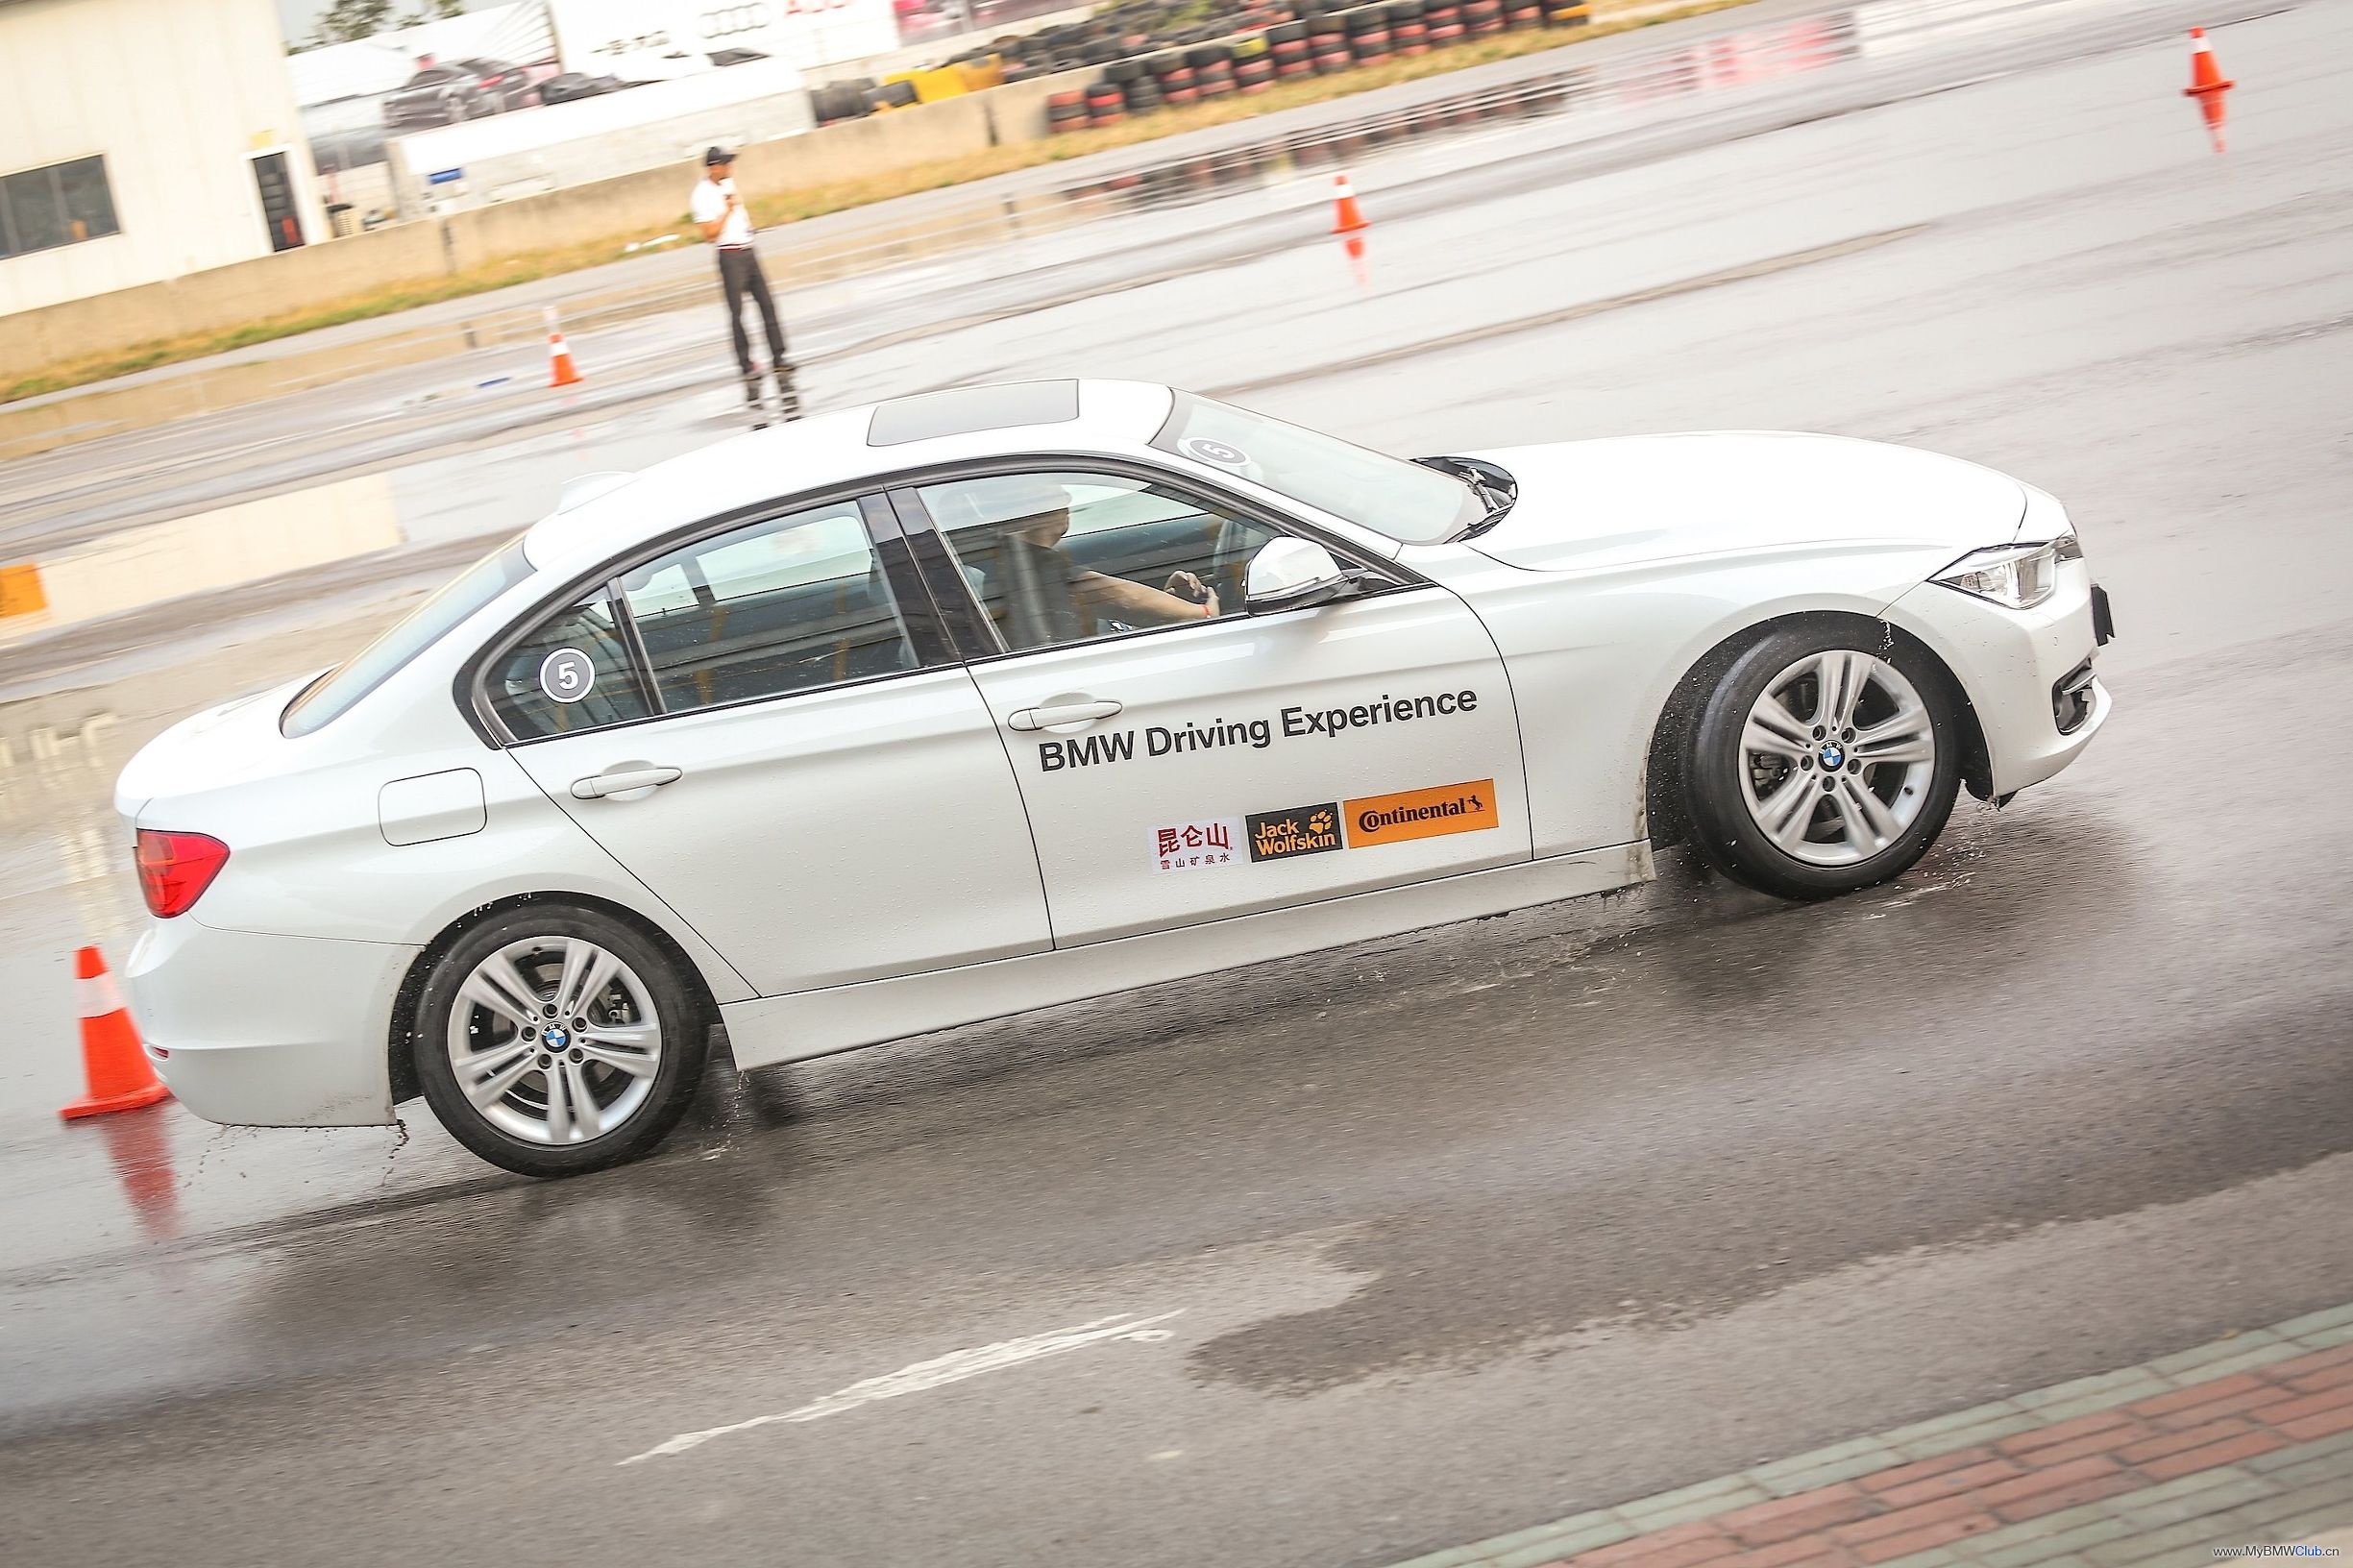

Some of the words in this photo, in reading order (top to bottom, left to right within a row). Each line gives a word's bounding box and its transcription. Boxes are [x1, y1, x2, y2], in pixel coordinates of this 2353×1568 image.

[558, 661, 579, 690] 5
[1039, 730, 1135, 772] BMW
[1146, 717, 1271, 757] Driving
[1281, 689, 1478, 738] Experience
[1255, 819, 1300, 839] Jack
[1359, 797, 1466, 833] Continental
[1158, 822, 1230, 858] 昆仑山
[1255, 832, 1336, 856] Wolfskin
[1160, 852, 1230, 870] 雪山矿泉水
